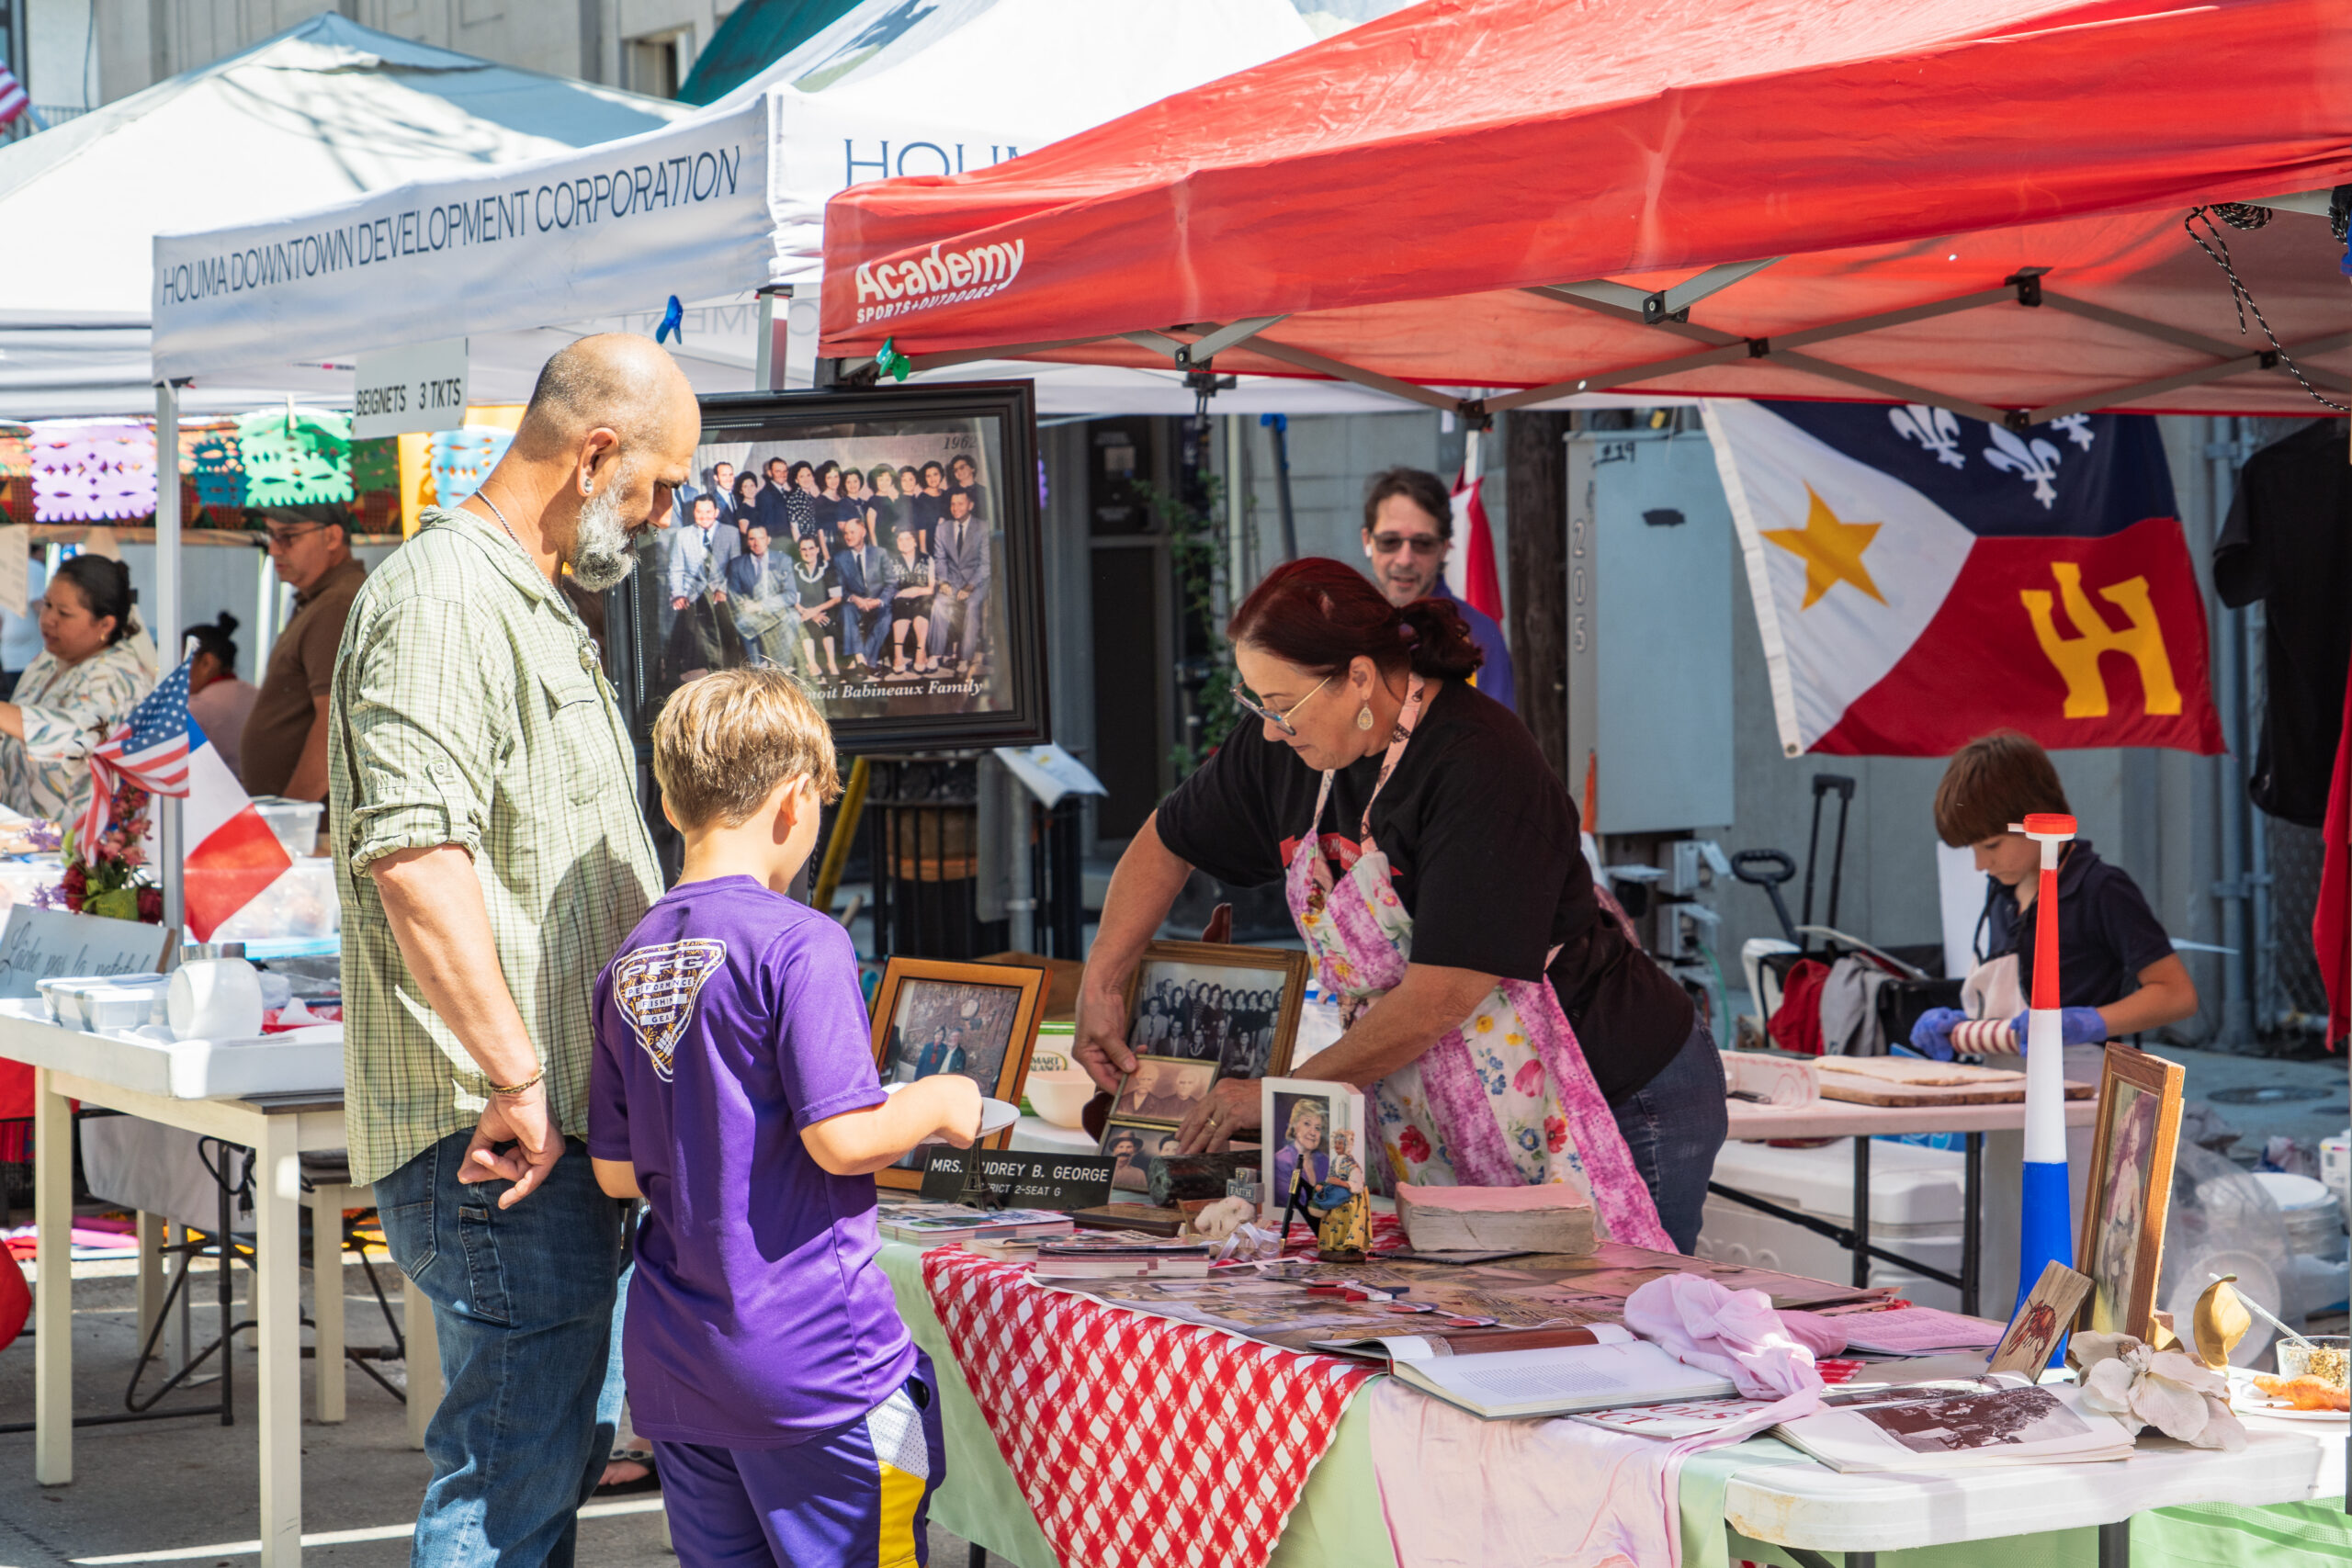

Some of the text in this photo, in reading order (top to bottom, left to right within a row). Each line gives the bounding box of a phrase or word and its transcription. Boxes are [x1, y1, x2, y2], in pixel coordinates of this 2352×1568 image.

[162, 145, 740, 306] HOUMA DOWNTOWN DEVELOPMENT CORPORATION
[854, 238, 1024, 304] Academy
[356, 378, 461, 417] BEIGNETS 3 TKTS
[842, 683, 924, 699] Babineaux
[927, 679, 983, 697] Family
[620, 955, 706, 984] PFG
[628, 978, 692, 996] PEFORMNCE
[931, 1158, 1110, 1182] MRS. UDREY B. GEORGE
[1013, 1184, 1050, 1197] 2-SEAT
[1230, 1185, 1251, 1198] FAITH
